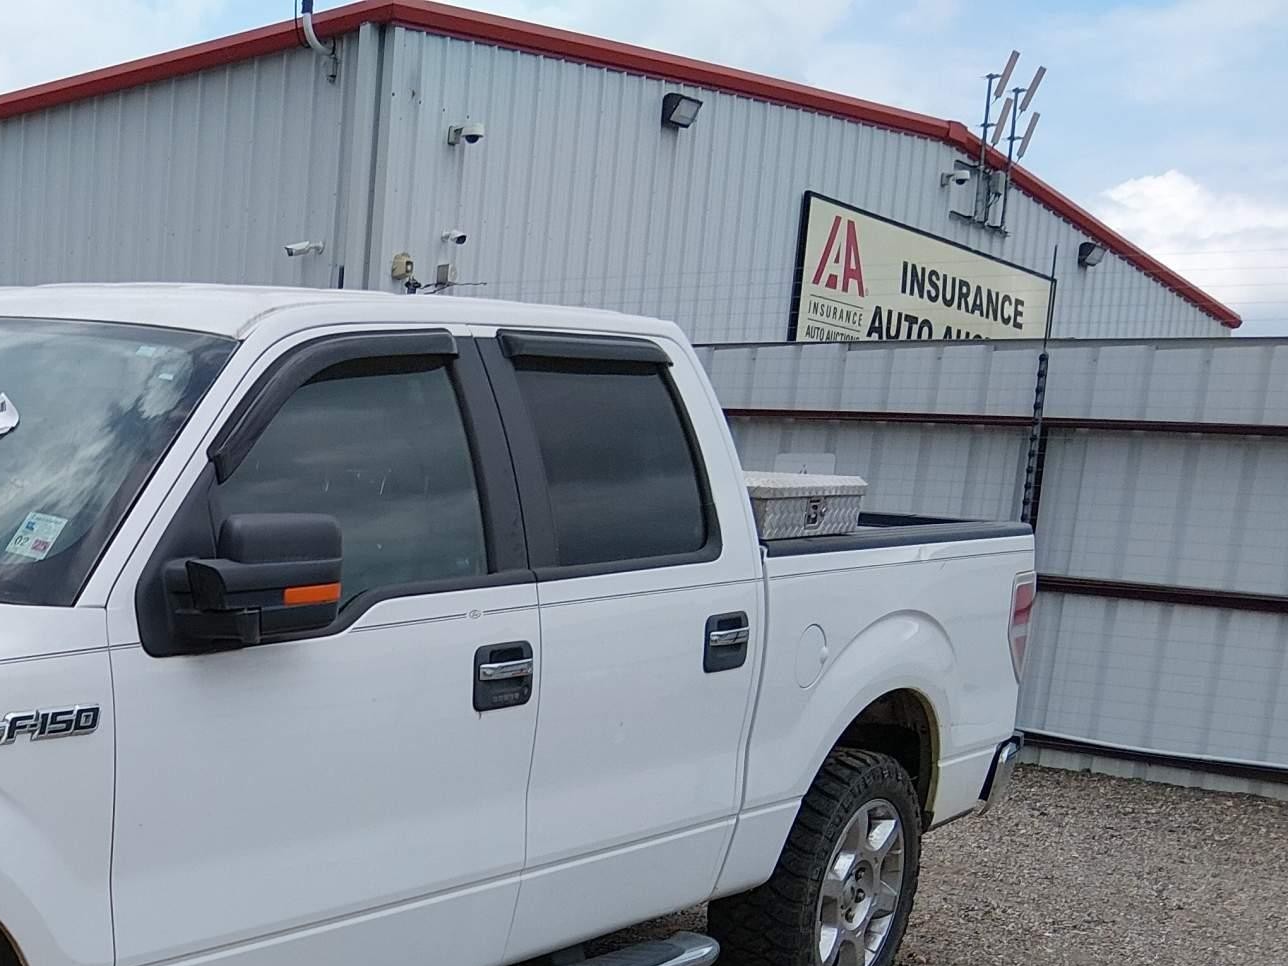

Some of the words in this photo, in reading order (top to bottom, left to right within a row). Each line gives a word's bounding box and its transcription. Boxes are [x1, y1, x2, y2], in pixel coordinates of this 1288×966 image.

[901, 261, 1025, 330] INSURANCE
[808, 300, 863, 327] INSURANCE
[805, 325, 825, 341] AUTO
